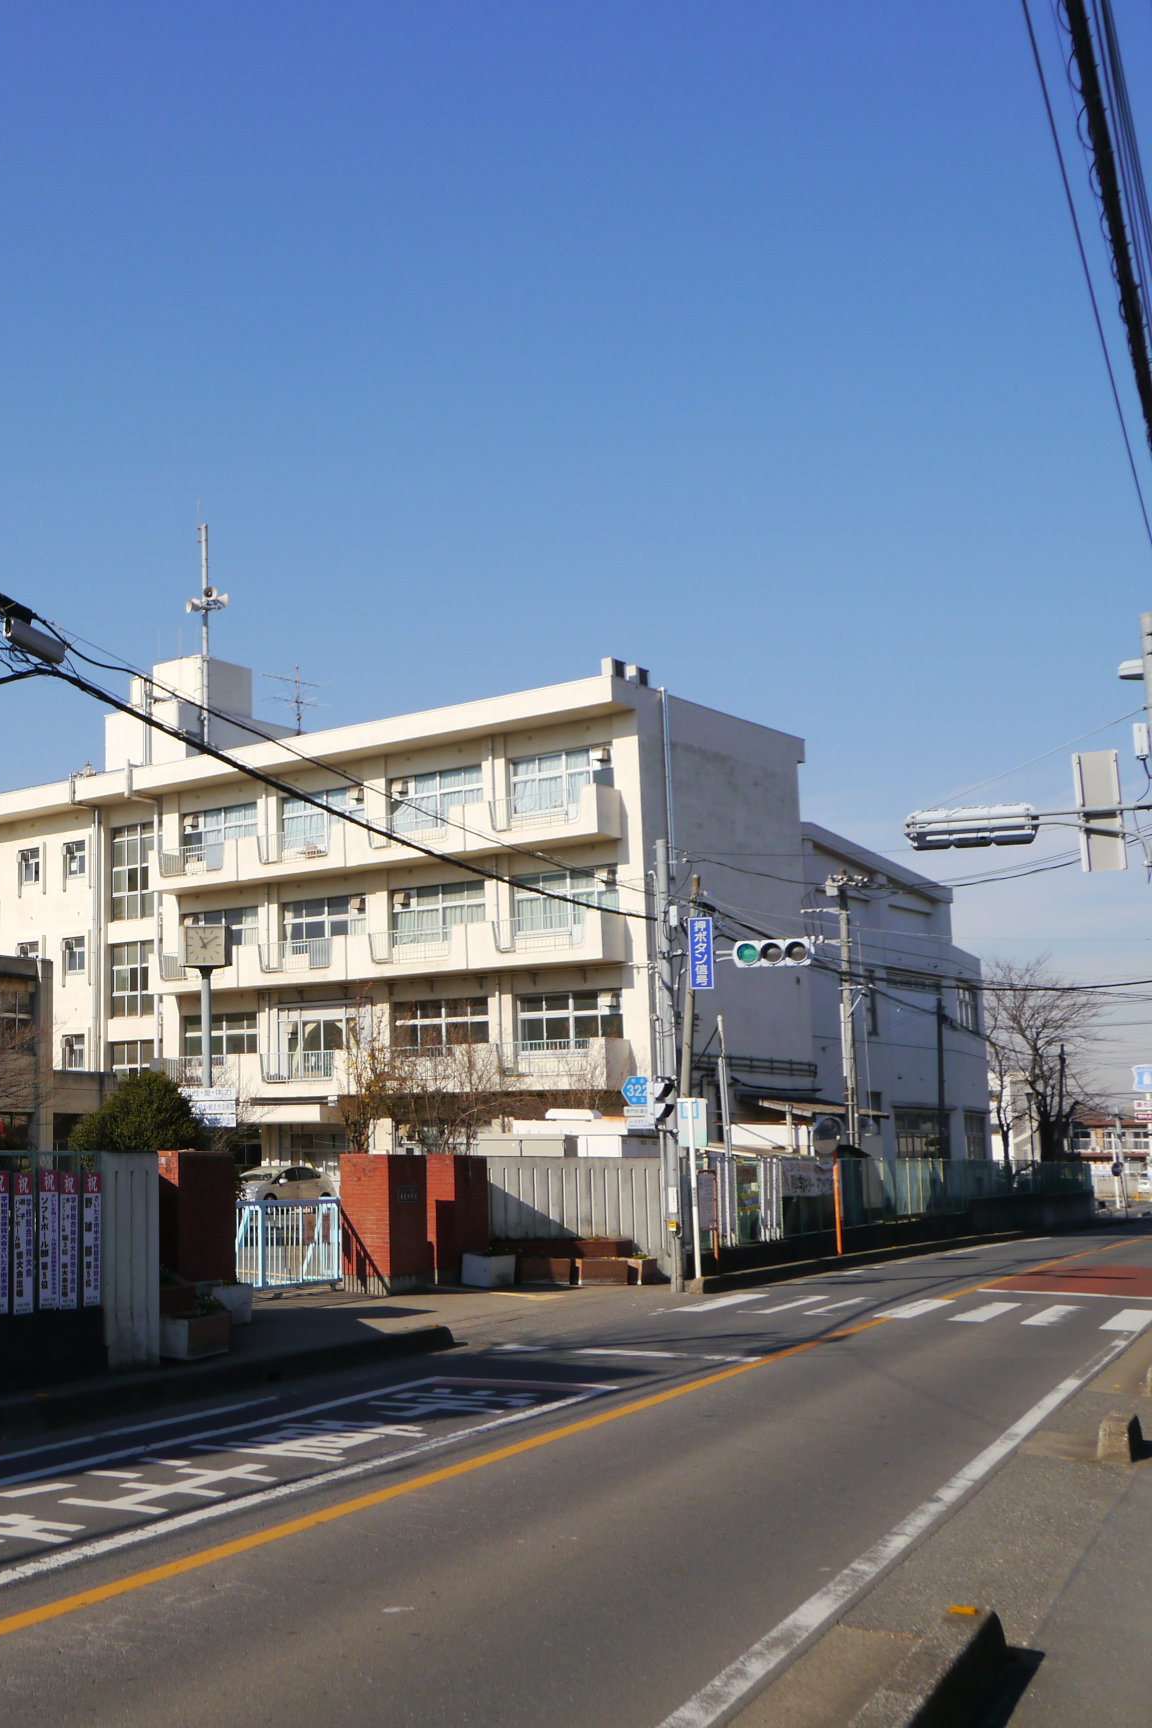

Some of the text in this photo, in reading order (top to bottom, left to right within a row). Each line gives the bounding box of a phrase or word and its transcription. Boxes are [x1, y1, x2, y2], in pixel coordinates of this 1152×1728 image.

[694, 920, 708, 986] 押ボタン信号
[18, 1174, 28, 1194] 祝
[44, 1172, 55, 1190] 祝
[64, 1175, 74, 1193] 祝
[88, 1174, 97, 1192] 祝
